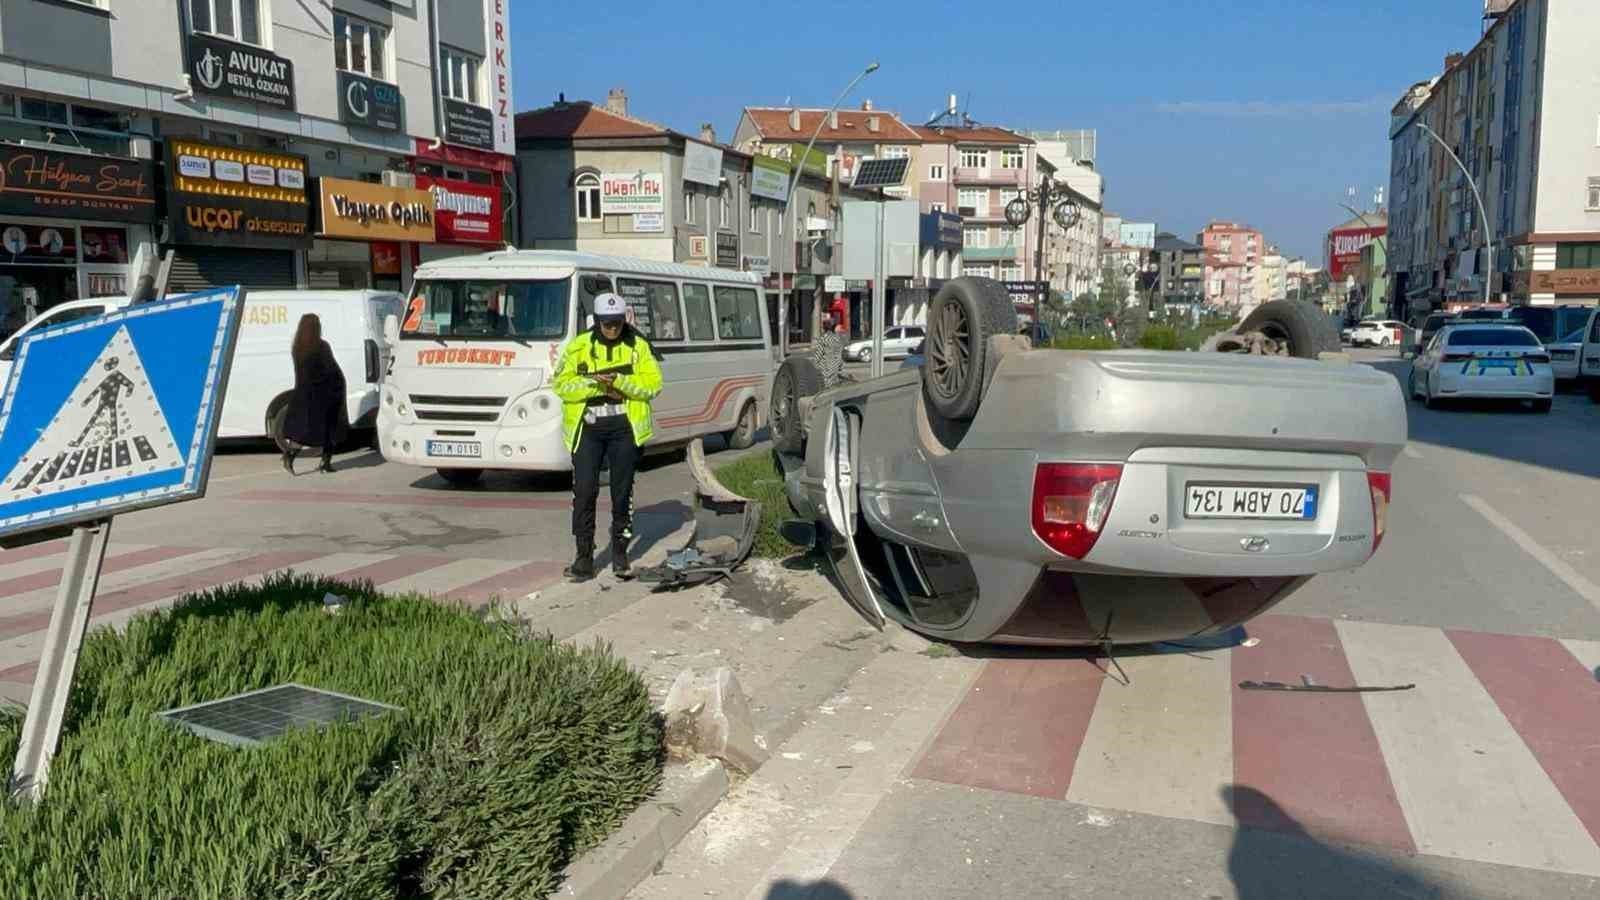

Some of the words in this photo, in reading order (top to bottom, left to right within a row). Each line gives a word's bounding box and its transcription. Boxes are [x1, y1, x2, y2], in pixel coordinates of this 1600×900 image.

[228, 50, 287, 79] AVUKAT
[227, 73, 254, 88] BETÜL
[256, 79, 290, 97] ÖZKAYA
[187, 206, 243, 232] uçar
[247, 216, 304, 233] aksesuar
[388, 201, 432, 227] Optik
[403, 295, 426, 332] 2
[1192, 489, 1223, 513] 134
[1233, 490, 1272, 513] ABM
[1280, 491, 1304, 514] 70
